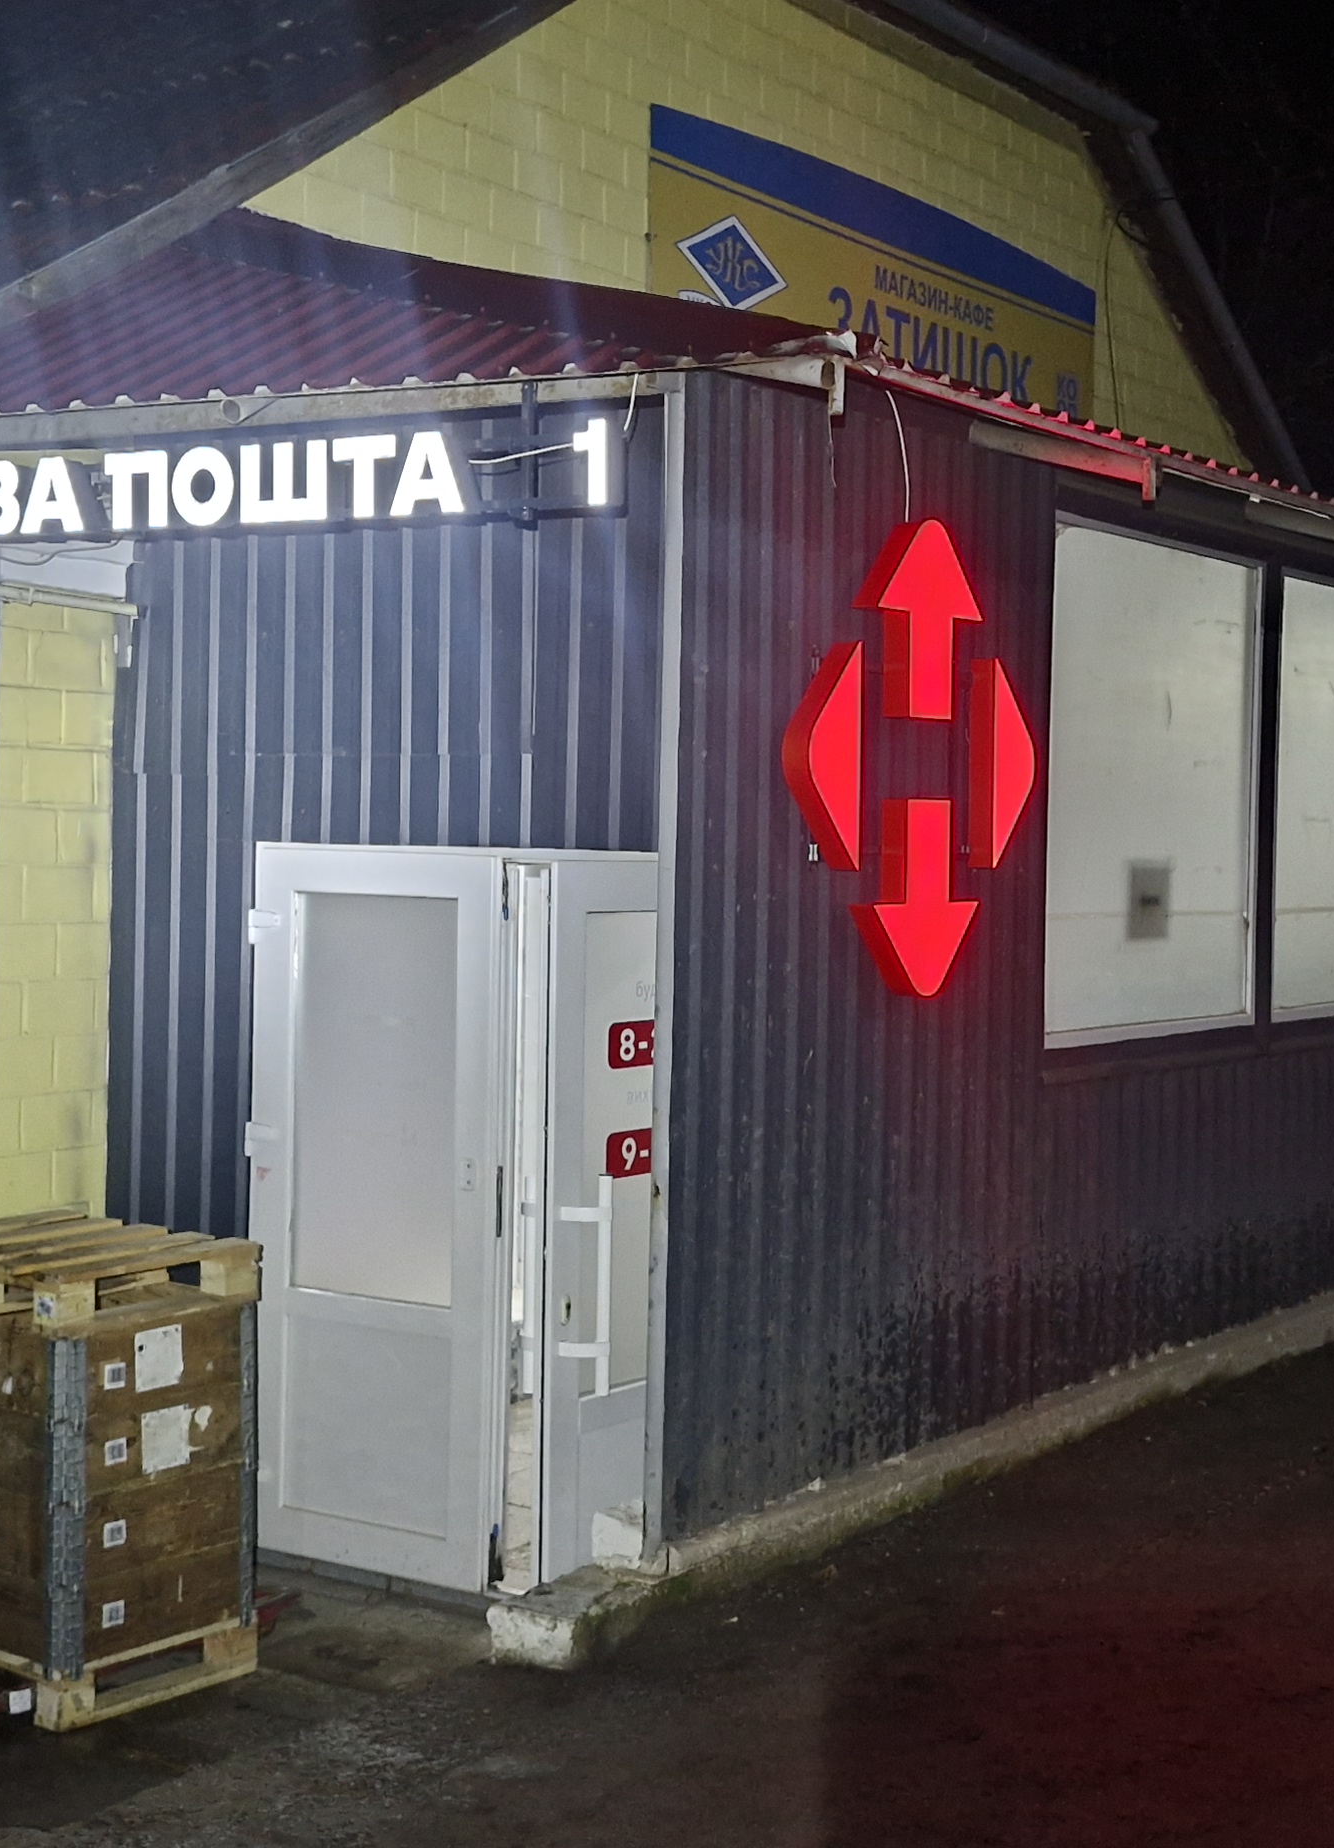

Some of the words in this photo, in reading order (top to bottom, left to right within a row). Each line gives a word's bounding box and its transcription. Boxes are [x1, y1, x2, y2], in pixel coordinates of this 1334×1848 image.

[874, 264, 995, 332] МАГАЗИН-КАФЕ
[104, 430, 464, 528] ПОШТА
[573, 418, 607, 506] 1
[620, 1028, 655, 1061] 8-
